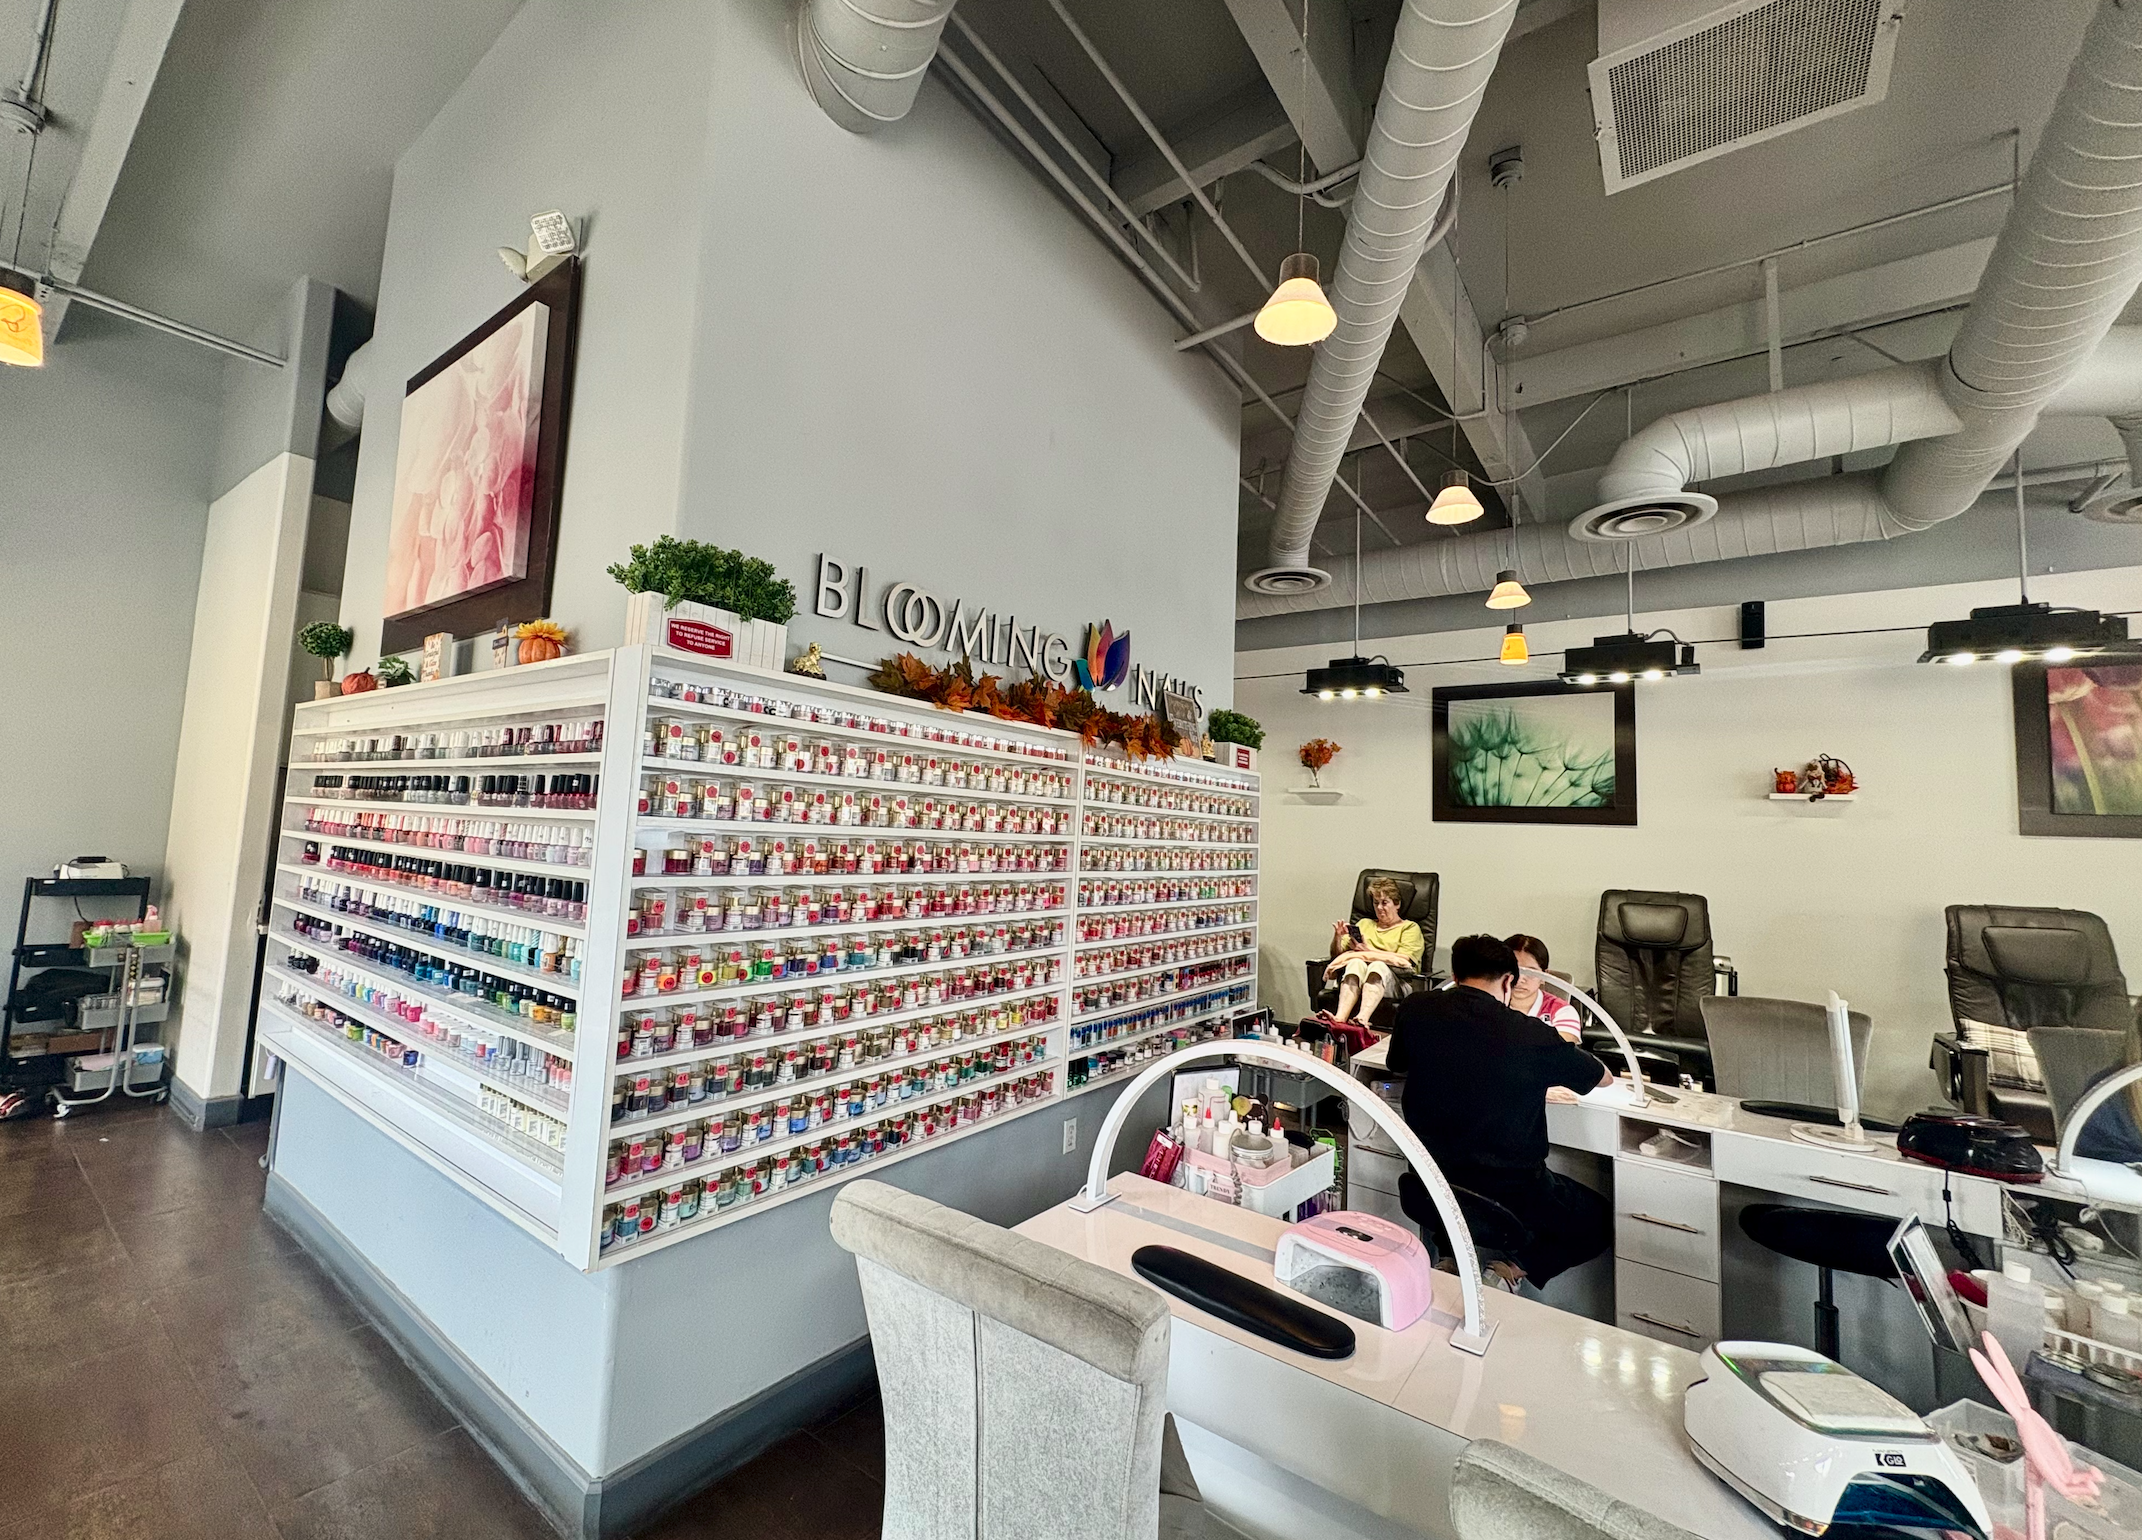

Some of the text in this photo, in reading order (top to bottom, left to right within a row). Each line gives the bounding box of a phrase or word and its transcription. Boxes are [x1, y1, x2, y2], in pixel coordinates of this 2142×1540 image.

[816, 552, 1072, 683] BLOOMING
[680, 625, 704, 635] RESERVE
[715, 633, 730, 641] RIGHT
[684, 632, 704, 641] REFUSE
[705, 637, 726, 646] SERVICE
[694, 642, 715, 650] ANYONE
